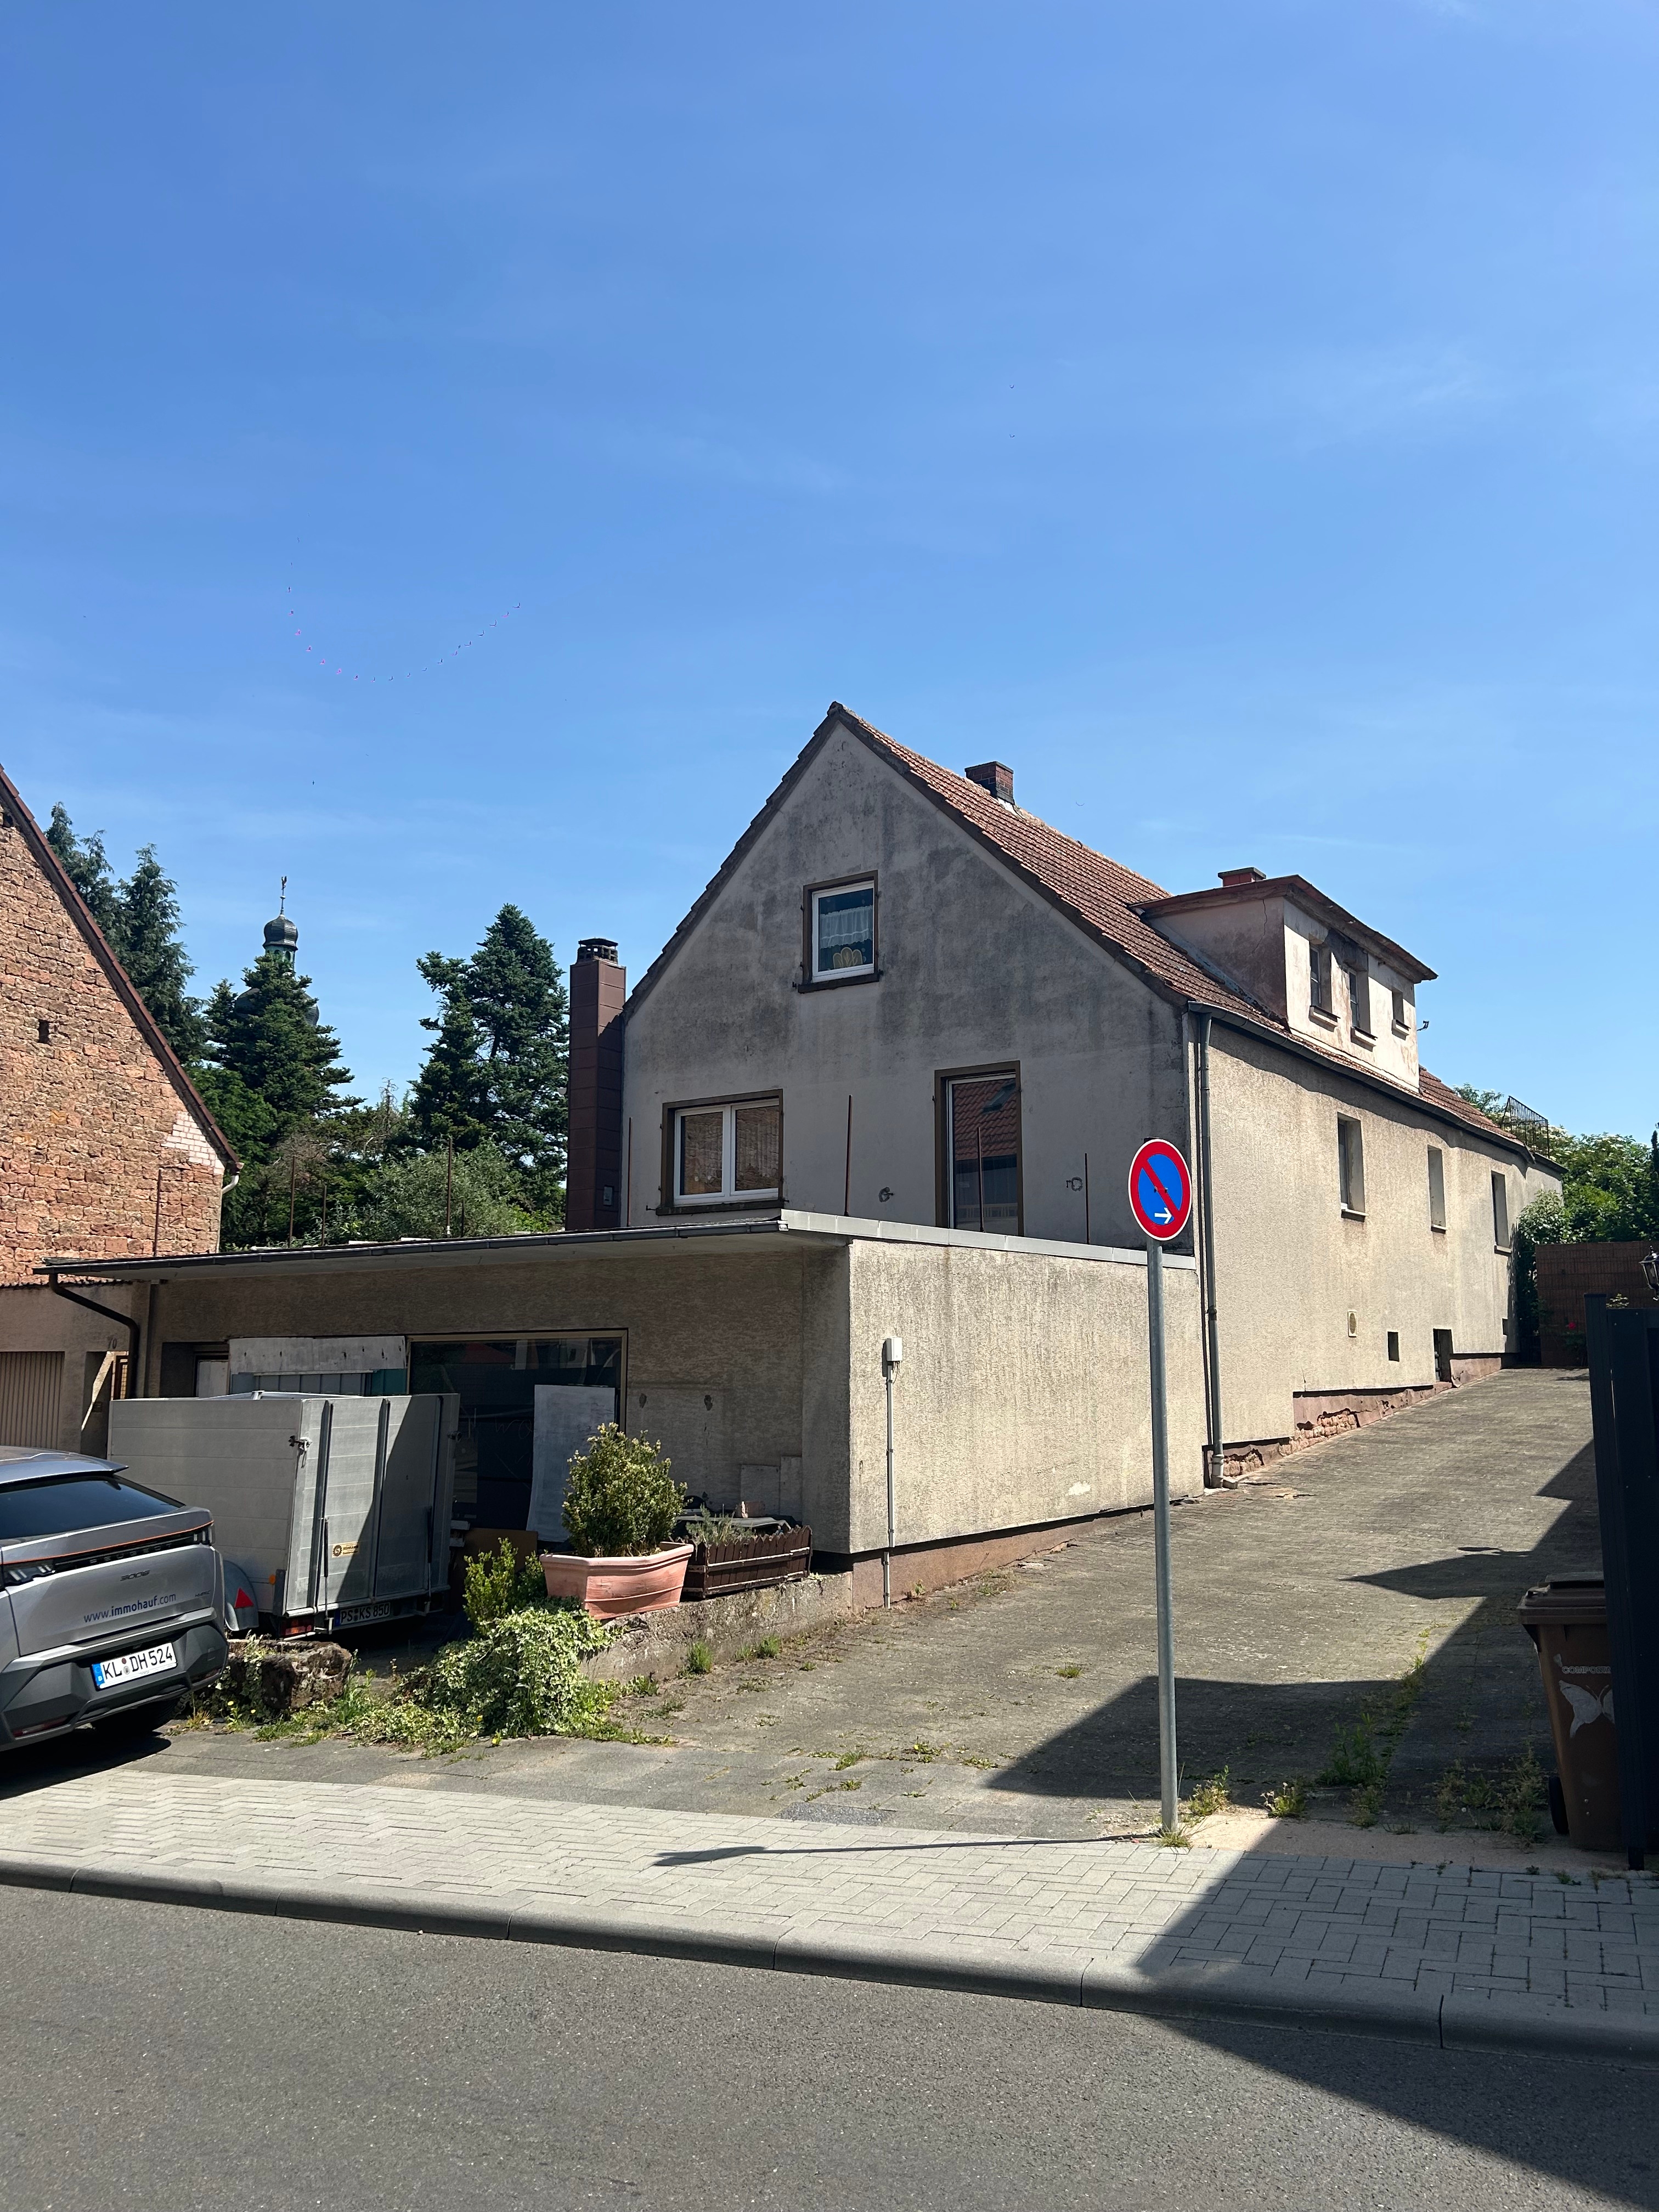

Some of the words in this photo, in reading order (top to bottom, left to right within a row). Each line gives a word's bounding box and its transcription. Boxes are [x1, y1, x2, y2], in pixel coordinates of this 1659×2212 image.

[83, 1593, 176, 1623] www.immohauf.com
[341, 1610, 353, 1623] PS
[359, 1606, 371, 1620] KS
[373, 1603, 390, 1617] 850
[103, 1662, 122, 1680] KL
[129, 1653, 148, 1672] DH
[148, 1645, 173, 1666] 524
[1561, 1666, 1611, 1674] COMPOSTA
